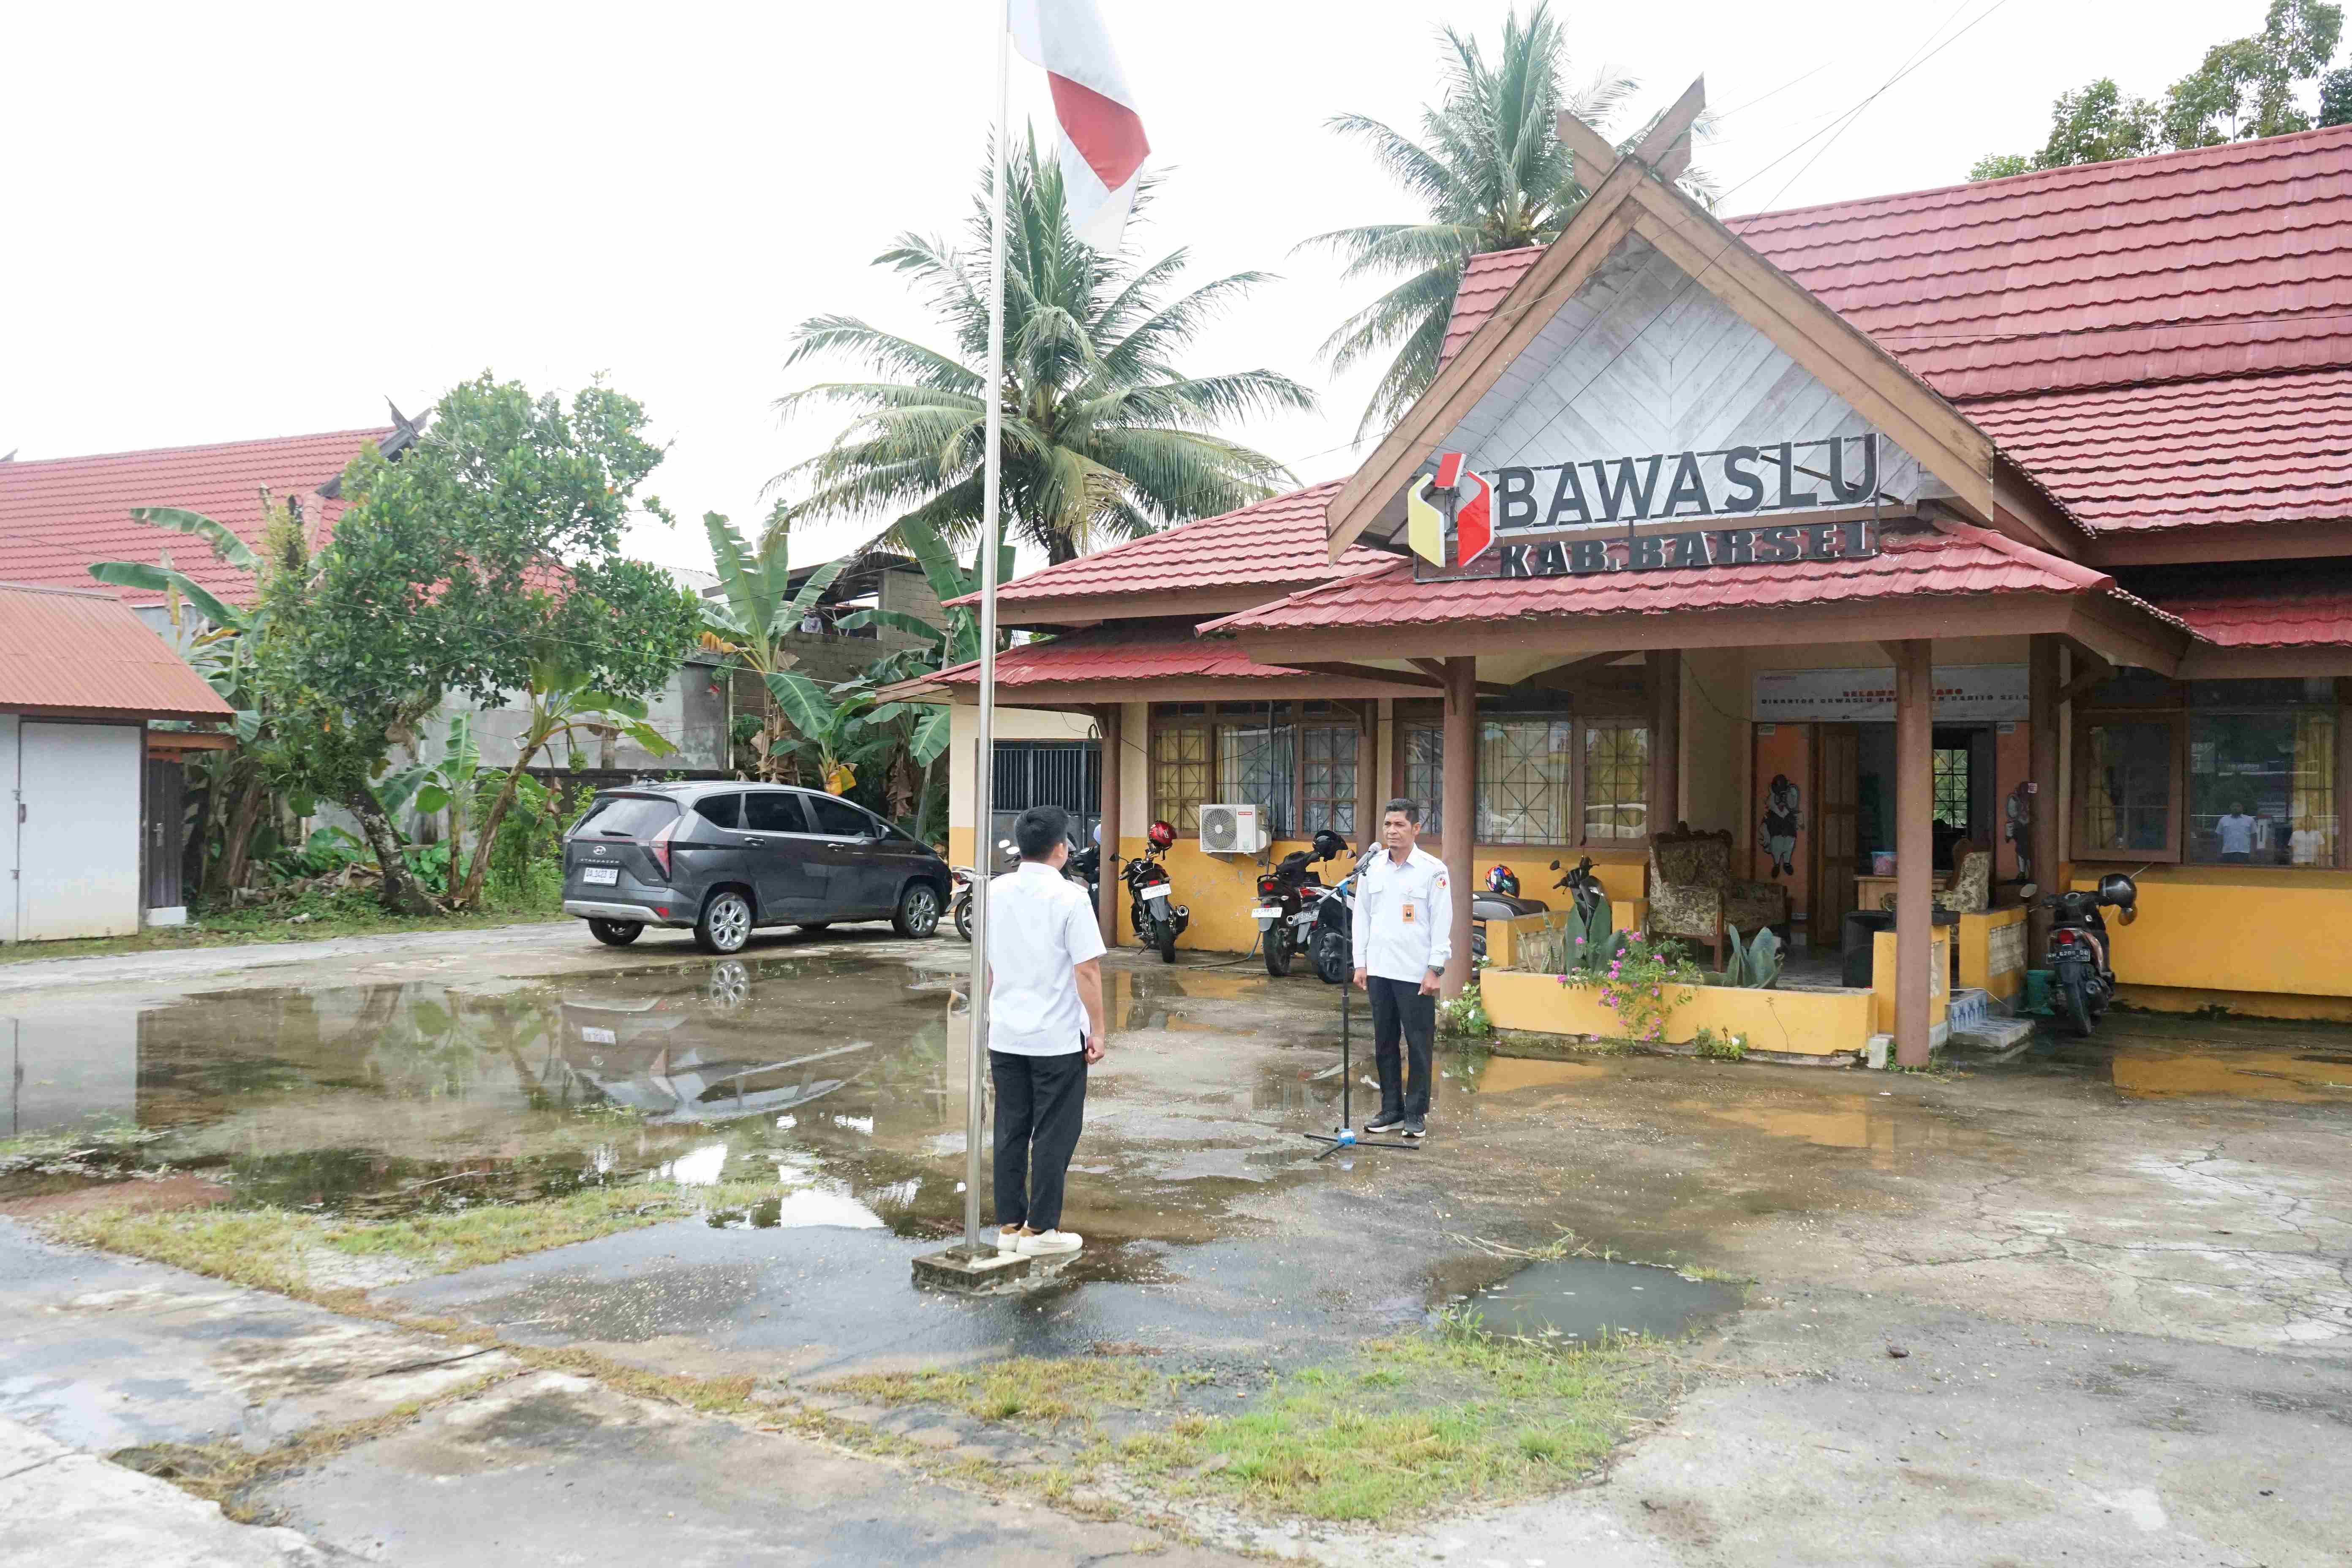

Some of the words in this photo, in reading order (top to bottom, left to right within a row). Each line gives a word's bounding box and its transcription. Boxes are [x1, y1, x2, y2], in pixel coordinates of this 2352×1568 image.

[1499, 433, 1879, 529] BAWASLU
[1500, 540, 1623, 577] KAB.
[1628, 523, 1877, 571] BARSEL
